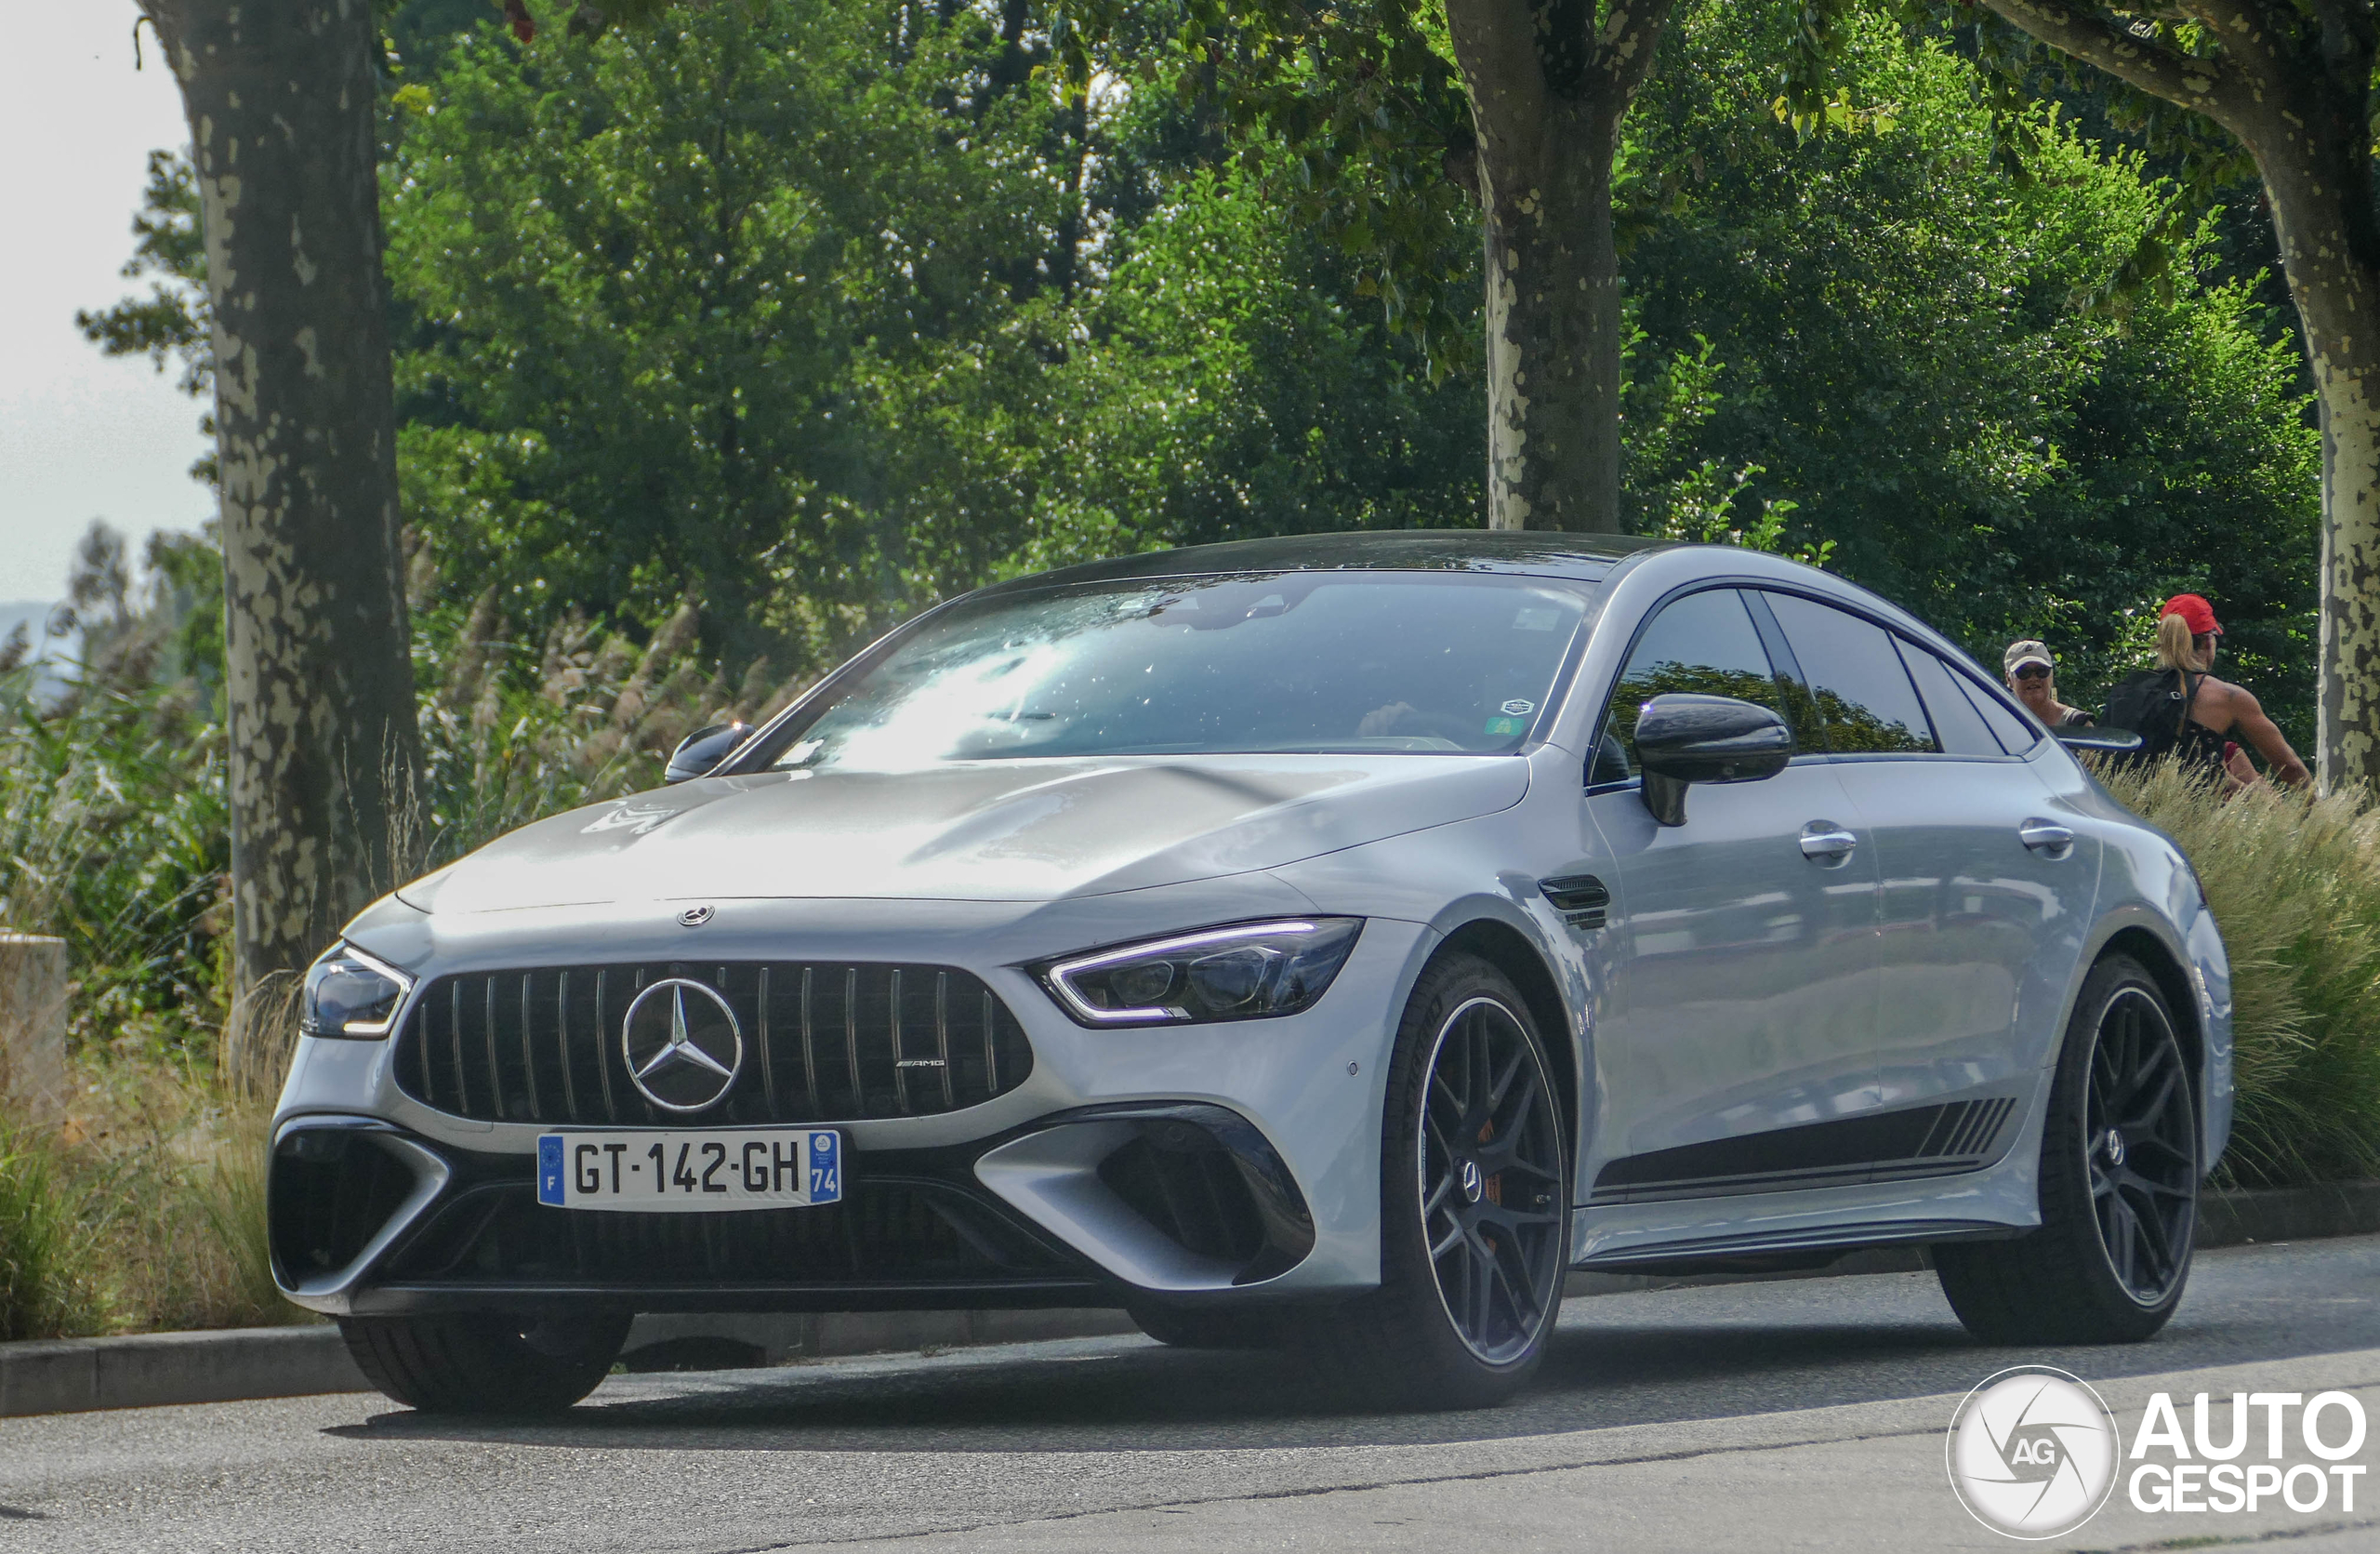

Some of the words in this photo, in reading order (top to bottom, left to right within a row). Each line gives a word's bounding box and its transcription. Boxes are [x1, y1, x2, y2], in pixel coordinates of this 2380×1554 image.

[575, 1141, 800, 1194] GT-142-GH
[547, 1176, 556, 1191] F
[812, 1168, 836, 1193] 74
